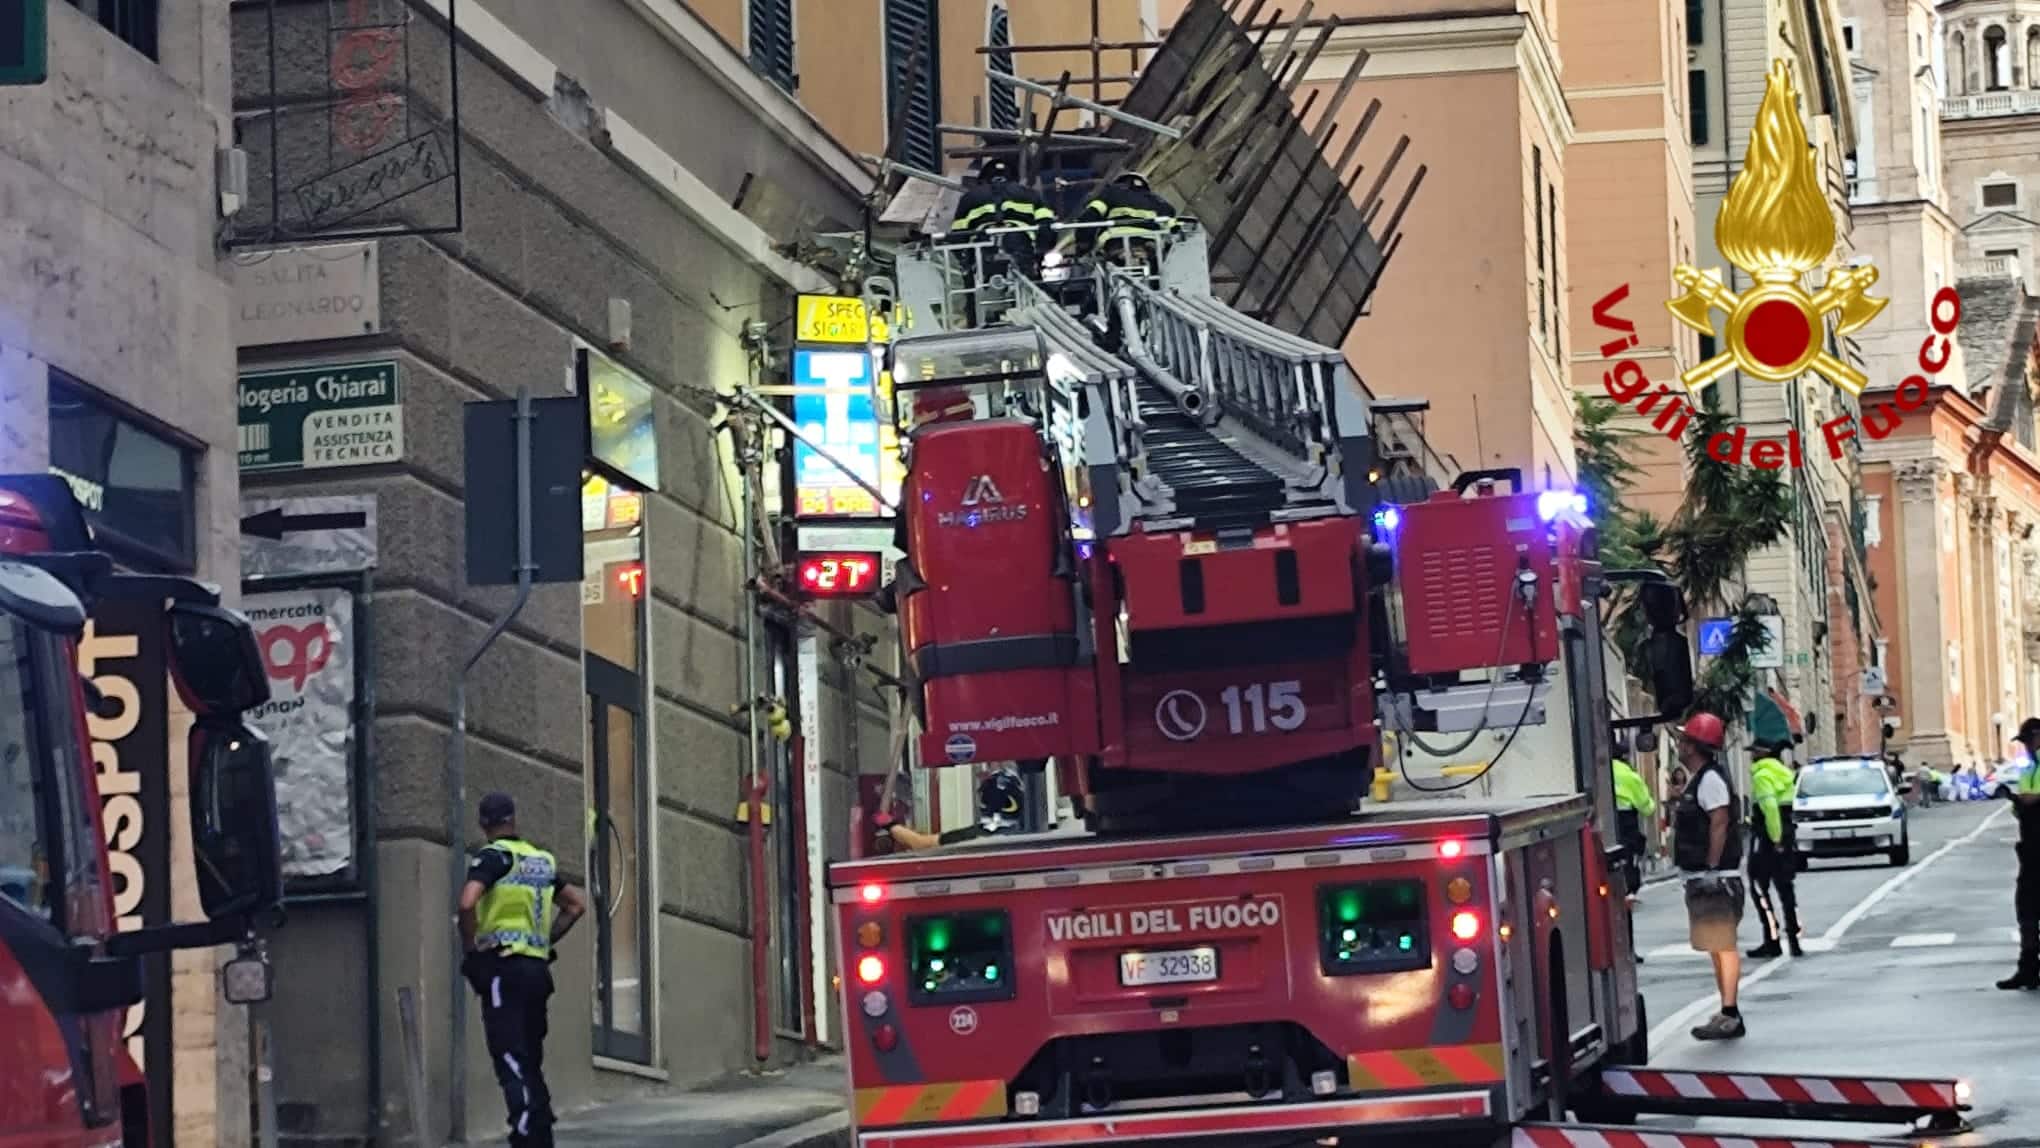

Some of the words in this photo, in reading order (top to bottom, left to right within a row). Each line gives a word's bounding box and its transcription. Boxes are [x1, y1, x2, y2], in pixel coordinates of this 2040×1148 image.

[240, 379, 308, 413] logeria
[315, 372, 386, 402] Chiarai
[313, 412, 393, 429] VENDITA
[313, 431, 393, 447] ASSISTENZA
[313, 444, 394, 461] TECNICA
[1221, 680, 1305, 734] 115
[1048, 911, 1123, 940] VIGILI
[1131, 909, 1183, 935] DEL
[1190, 901, 1280, 930] FUOCO
[1125, 956, 1146, 980] VF
[1159, 954, 1212, 977] 32938
